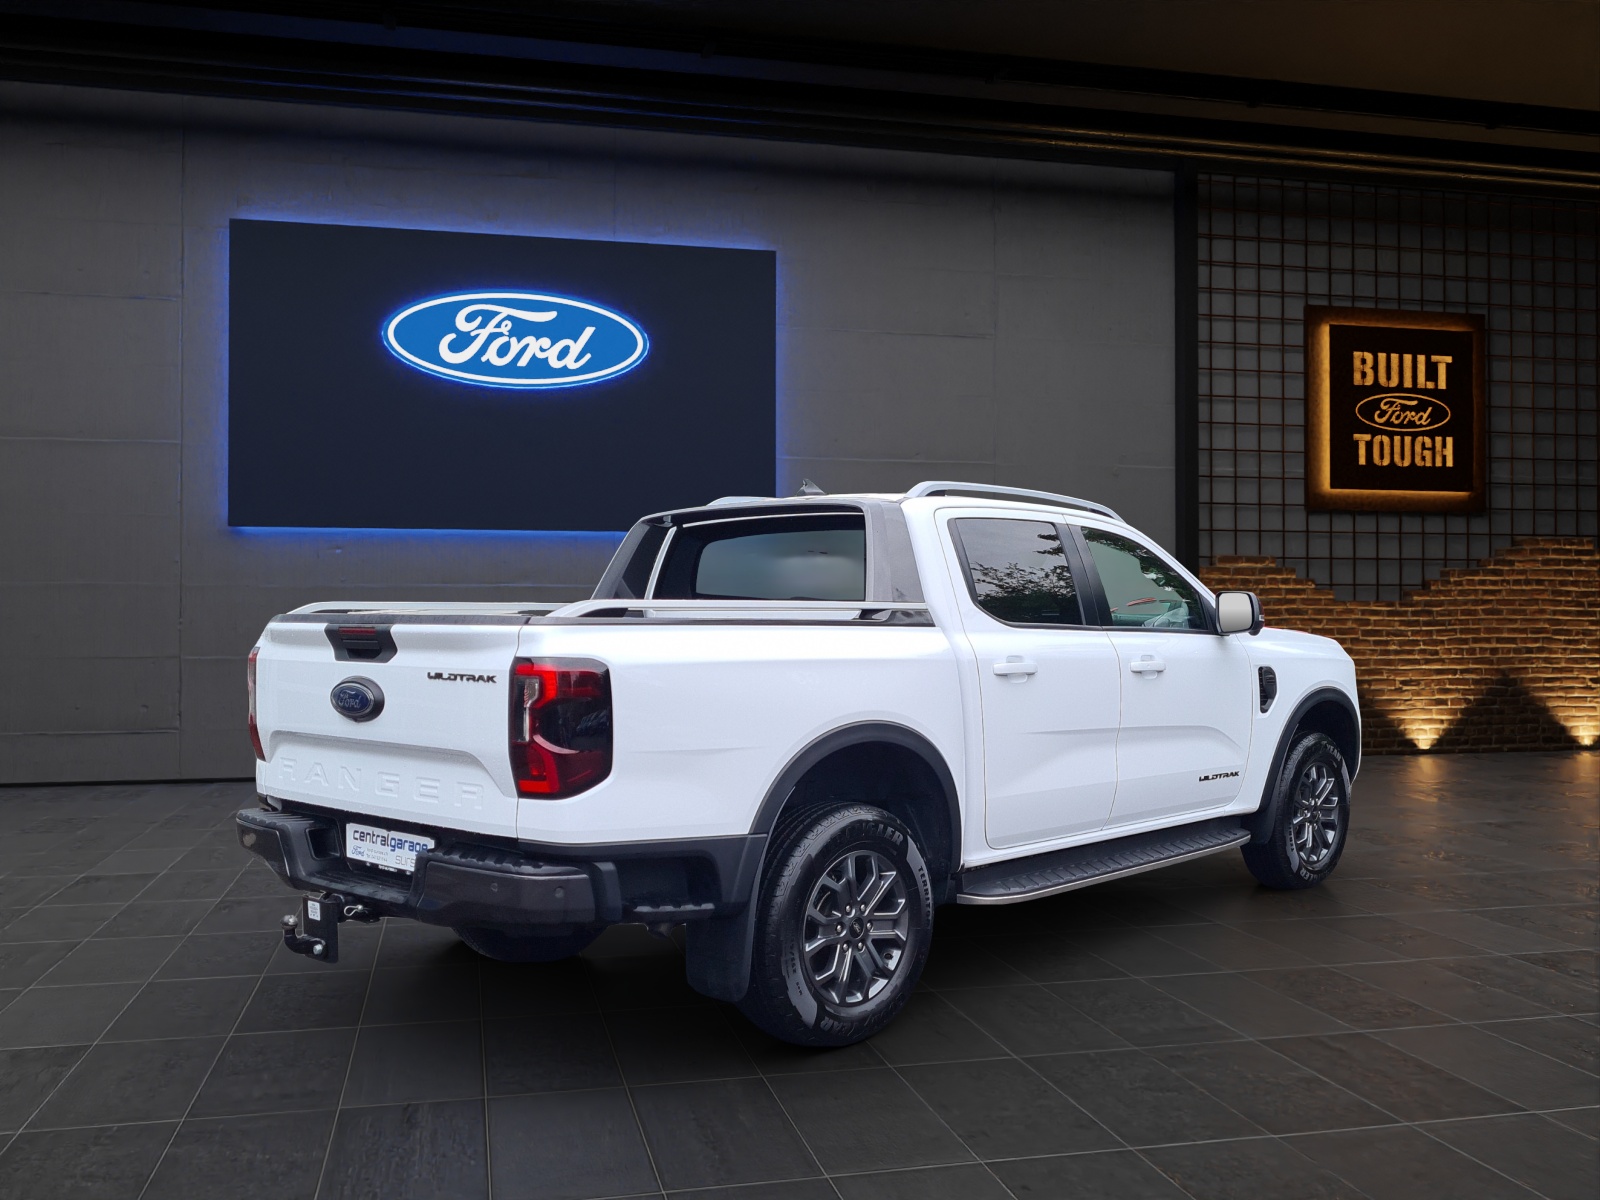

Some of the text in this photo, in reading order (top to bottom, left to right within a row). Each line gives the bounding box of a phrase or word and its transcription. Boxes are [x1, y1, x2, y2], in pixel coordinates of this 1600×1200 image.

[439, 304, 596, 369] Ford
[1353, 351, 1453, 389] BUILT
[1374, 397, 1433, 425] Ford
[1353, 433, 1454, 467] TOUGH
[427, 671, 497, 684] WILDTRAK
[338, 689, 362, 709] Ford
[278, 757, 484, 809] RANGER
[1199, 771, 1240, 782] WILDTRAK
